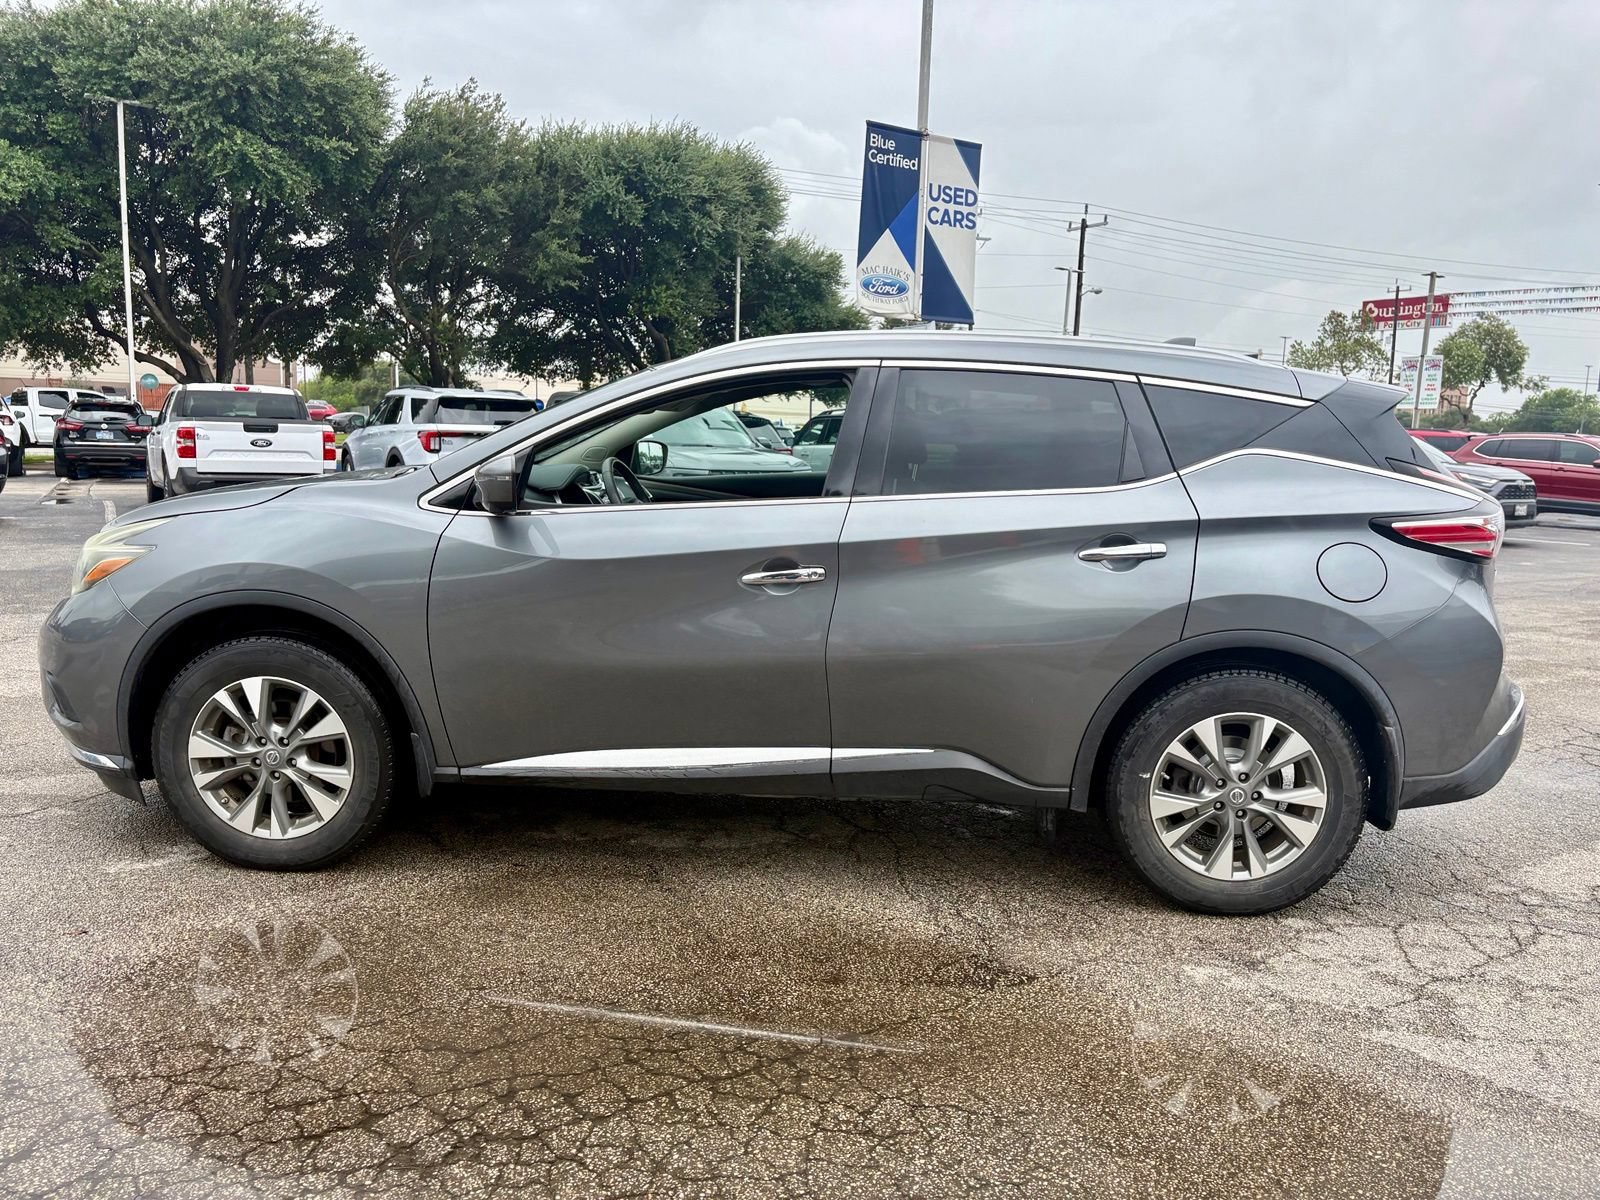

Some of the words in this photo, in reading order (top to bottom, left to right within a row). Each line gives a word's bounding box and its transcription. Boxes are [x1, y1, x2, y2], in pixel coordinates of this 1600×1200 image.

[870, 133, 896, 151] Blue
[868, 149, 919, 171] Certified
[928, 183, 978, 207] USED
[927, 206, 977, 230] CARS
[861, 265, 880, 276] MAC
[868, 277, 901, 294] Ford
[1366, 302, 1444, 319] Buringtn
[1383, 320, 1404, 329] Paty
